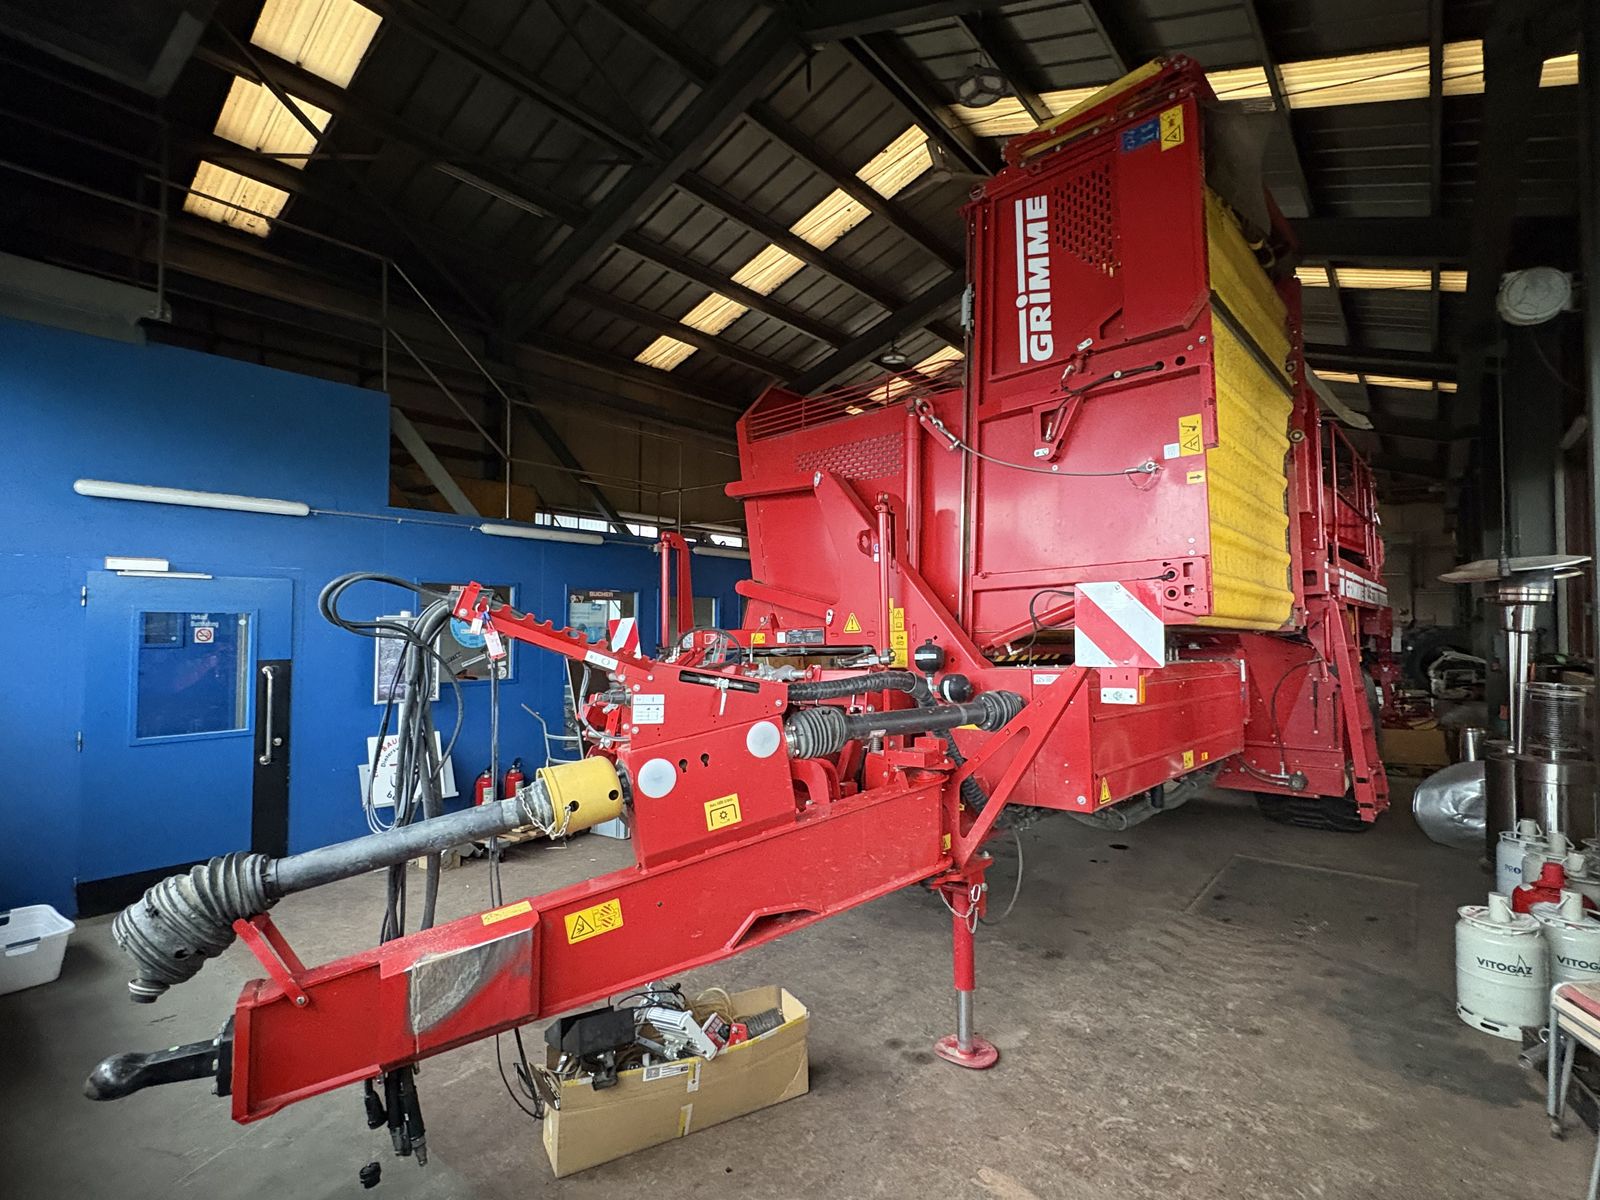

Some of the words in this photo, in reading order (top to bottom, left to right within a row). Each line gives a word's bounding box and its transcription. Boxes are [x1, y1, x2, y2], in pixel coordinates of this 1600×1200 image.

[1016, 194, 1054, 363] GRIMME
[1504, 863, 1522, 874] PRO
[1476, 955, 1533, 975] VITOGAZ
[1557, 955, 1600, 971] VITOG
